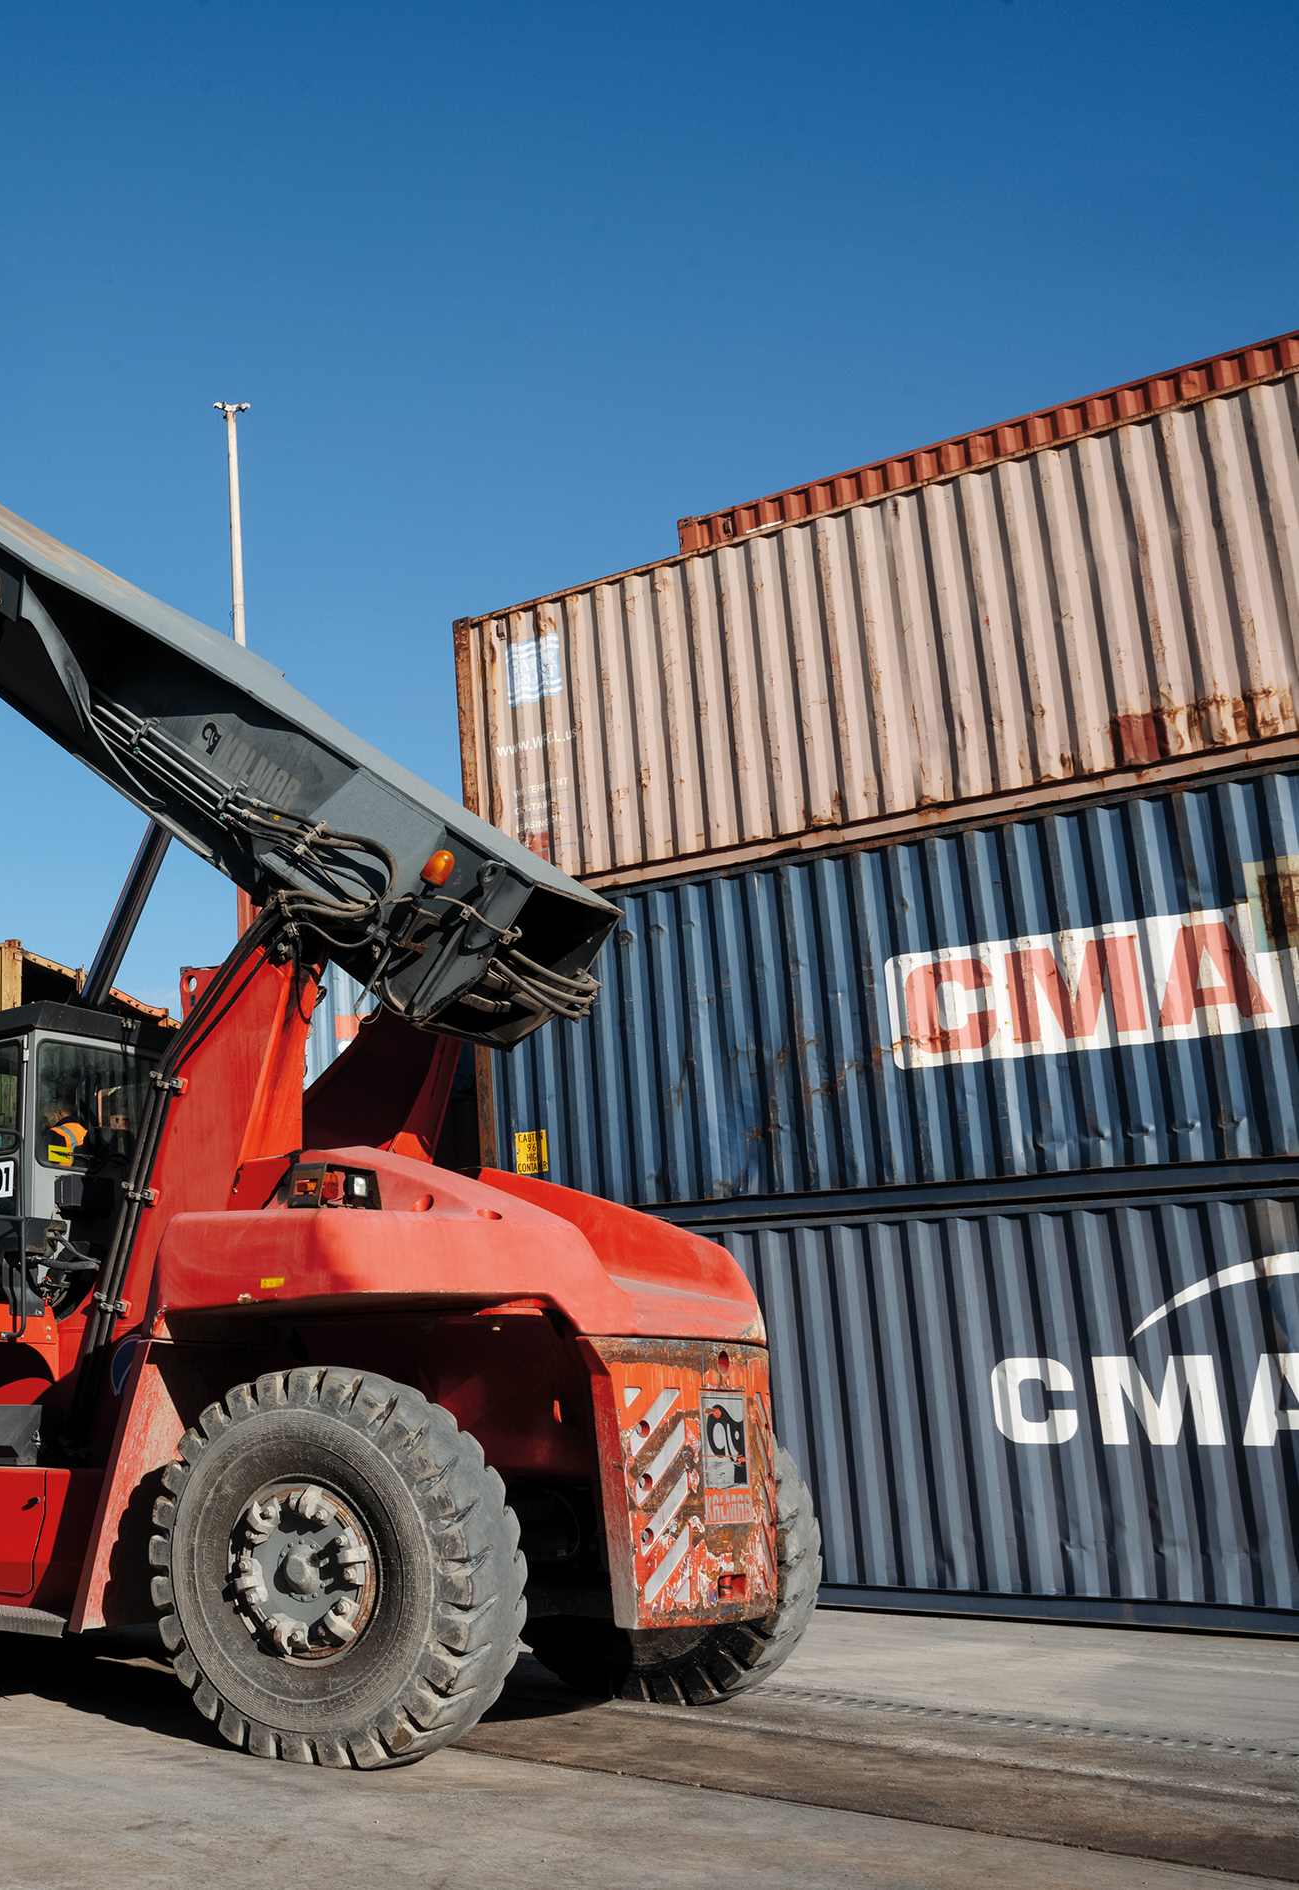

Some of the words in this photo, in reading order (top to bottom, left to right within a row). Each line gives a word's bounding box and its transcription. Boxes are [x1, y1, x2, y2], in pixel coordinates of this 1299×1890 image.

[513, 776, 569, 798] WATERFNT
[904, 922, 1274, 1054] CMA
[517, 1131, 544, 1143] CAUTN
[517, 1160, 548, 1173] CONTAER
[526, 1152, 539, 1163] HIG
[990, 1352, 1299, 1447] CMA
[704, 1494, 752, 1522] KALMAR
